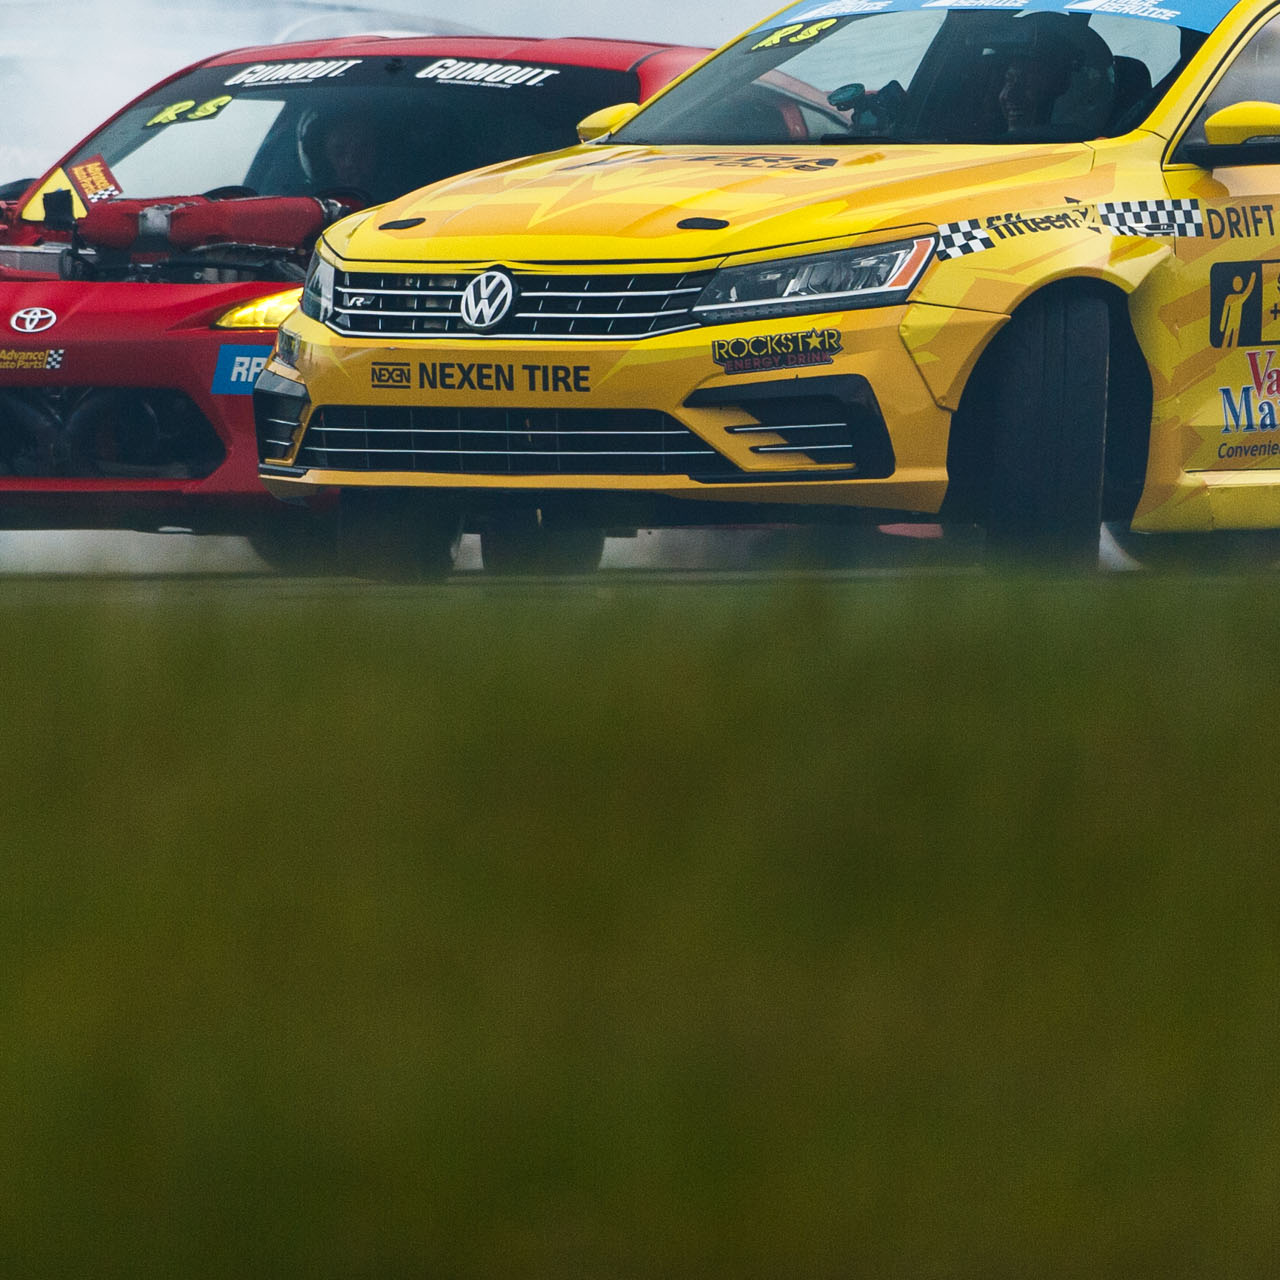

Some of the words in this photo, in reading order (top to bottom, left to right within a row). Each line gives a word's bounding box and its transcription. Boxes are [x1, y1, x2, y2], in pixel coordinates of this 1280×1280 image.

[223, 59, 364, 86] GUMOUT
[415, 58, 560, 86] GUMOUT
[1206, 204, 1275, 240] DRIFT
[17, 359, 42, 369] Parts
[371, 366, 411, 385] NEXEN
[419, 362, 514, 391] NEXEN
[522, 365, 591, 392] TIRE
